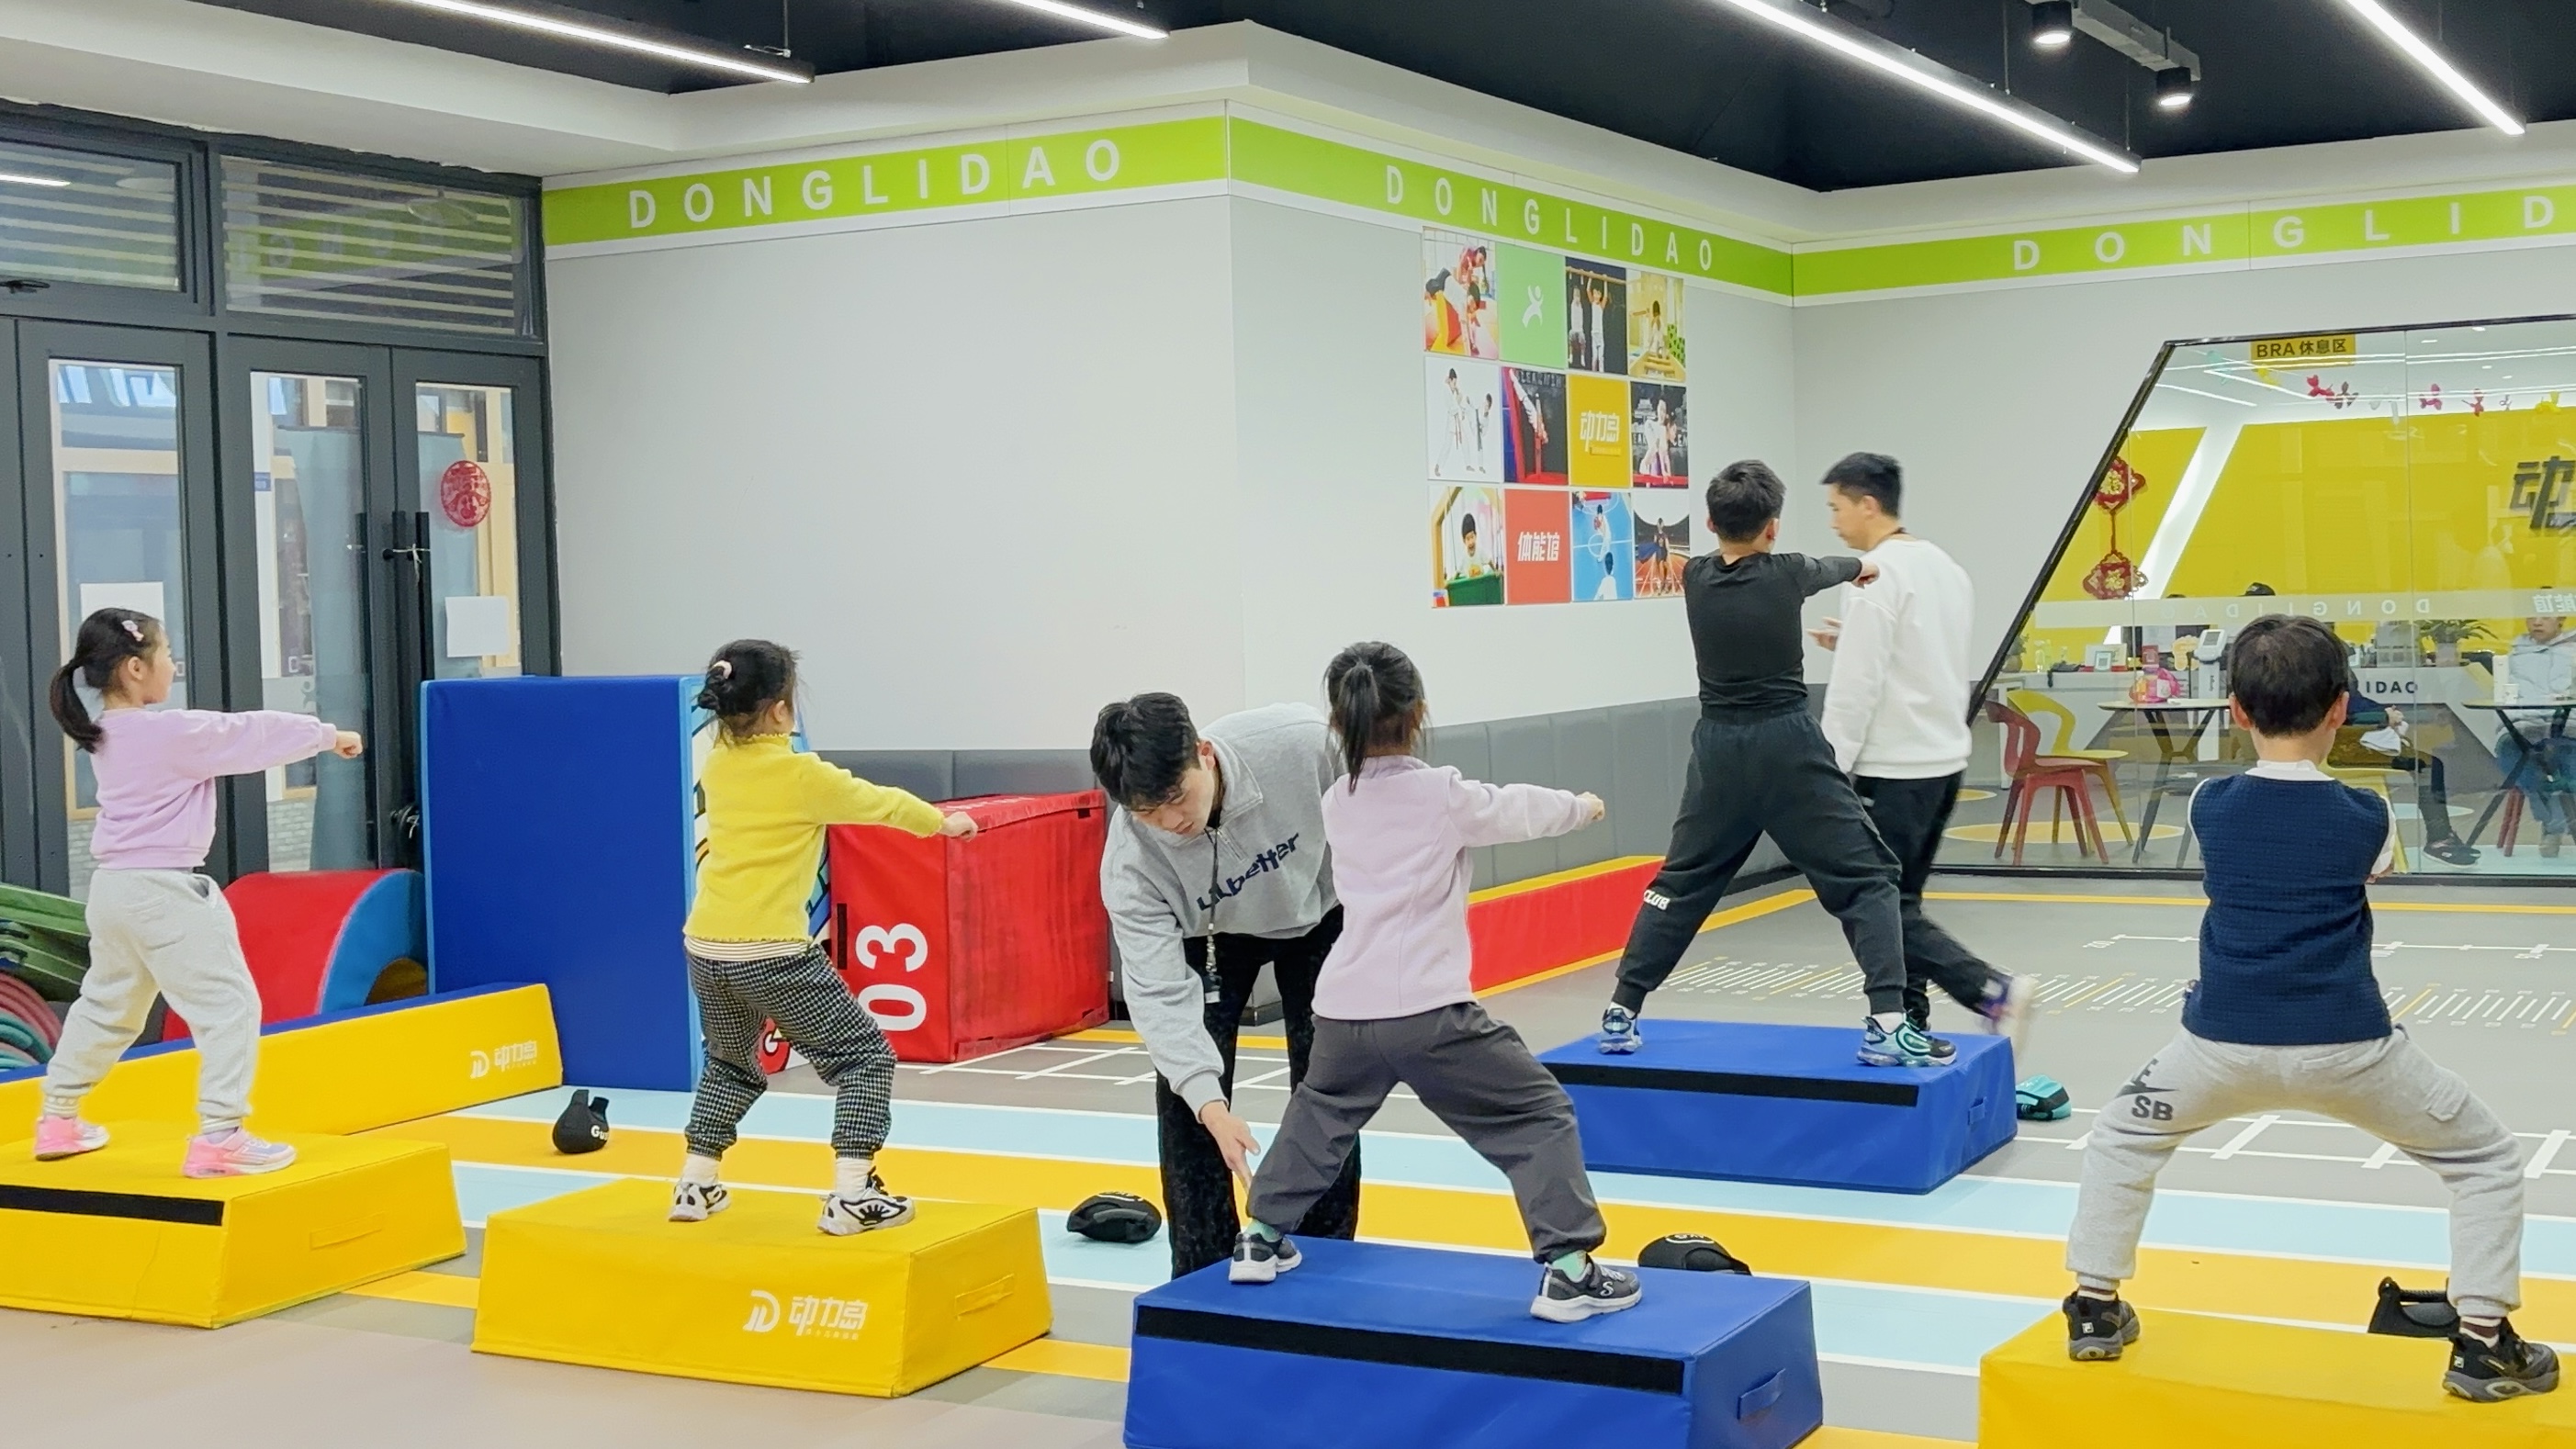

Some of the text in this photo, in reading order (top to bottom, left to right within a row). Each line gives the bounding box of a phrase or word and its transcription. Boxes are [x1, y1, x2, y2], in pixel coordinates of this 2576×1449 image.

[629, 138, 1120, 230] DONGLIDAO
[1386, 164, 1713, 272] DONGLIDAO
[2013, 195, 2555, 271] DONGLID
[2256, 337, 2347, 358] BRA 休息区
[1517, 531, 1560, 562] 体能馆
[855, 922, 928, 1032] 03
[2132, 1095, 2174, 1121] SB
[788, 1295, 869, 1336] 动力岛
